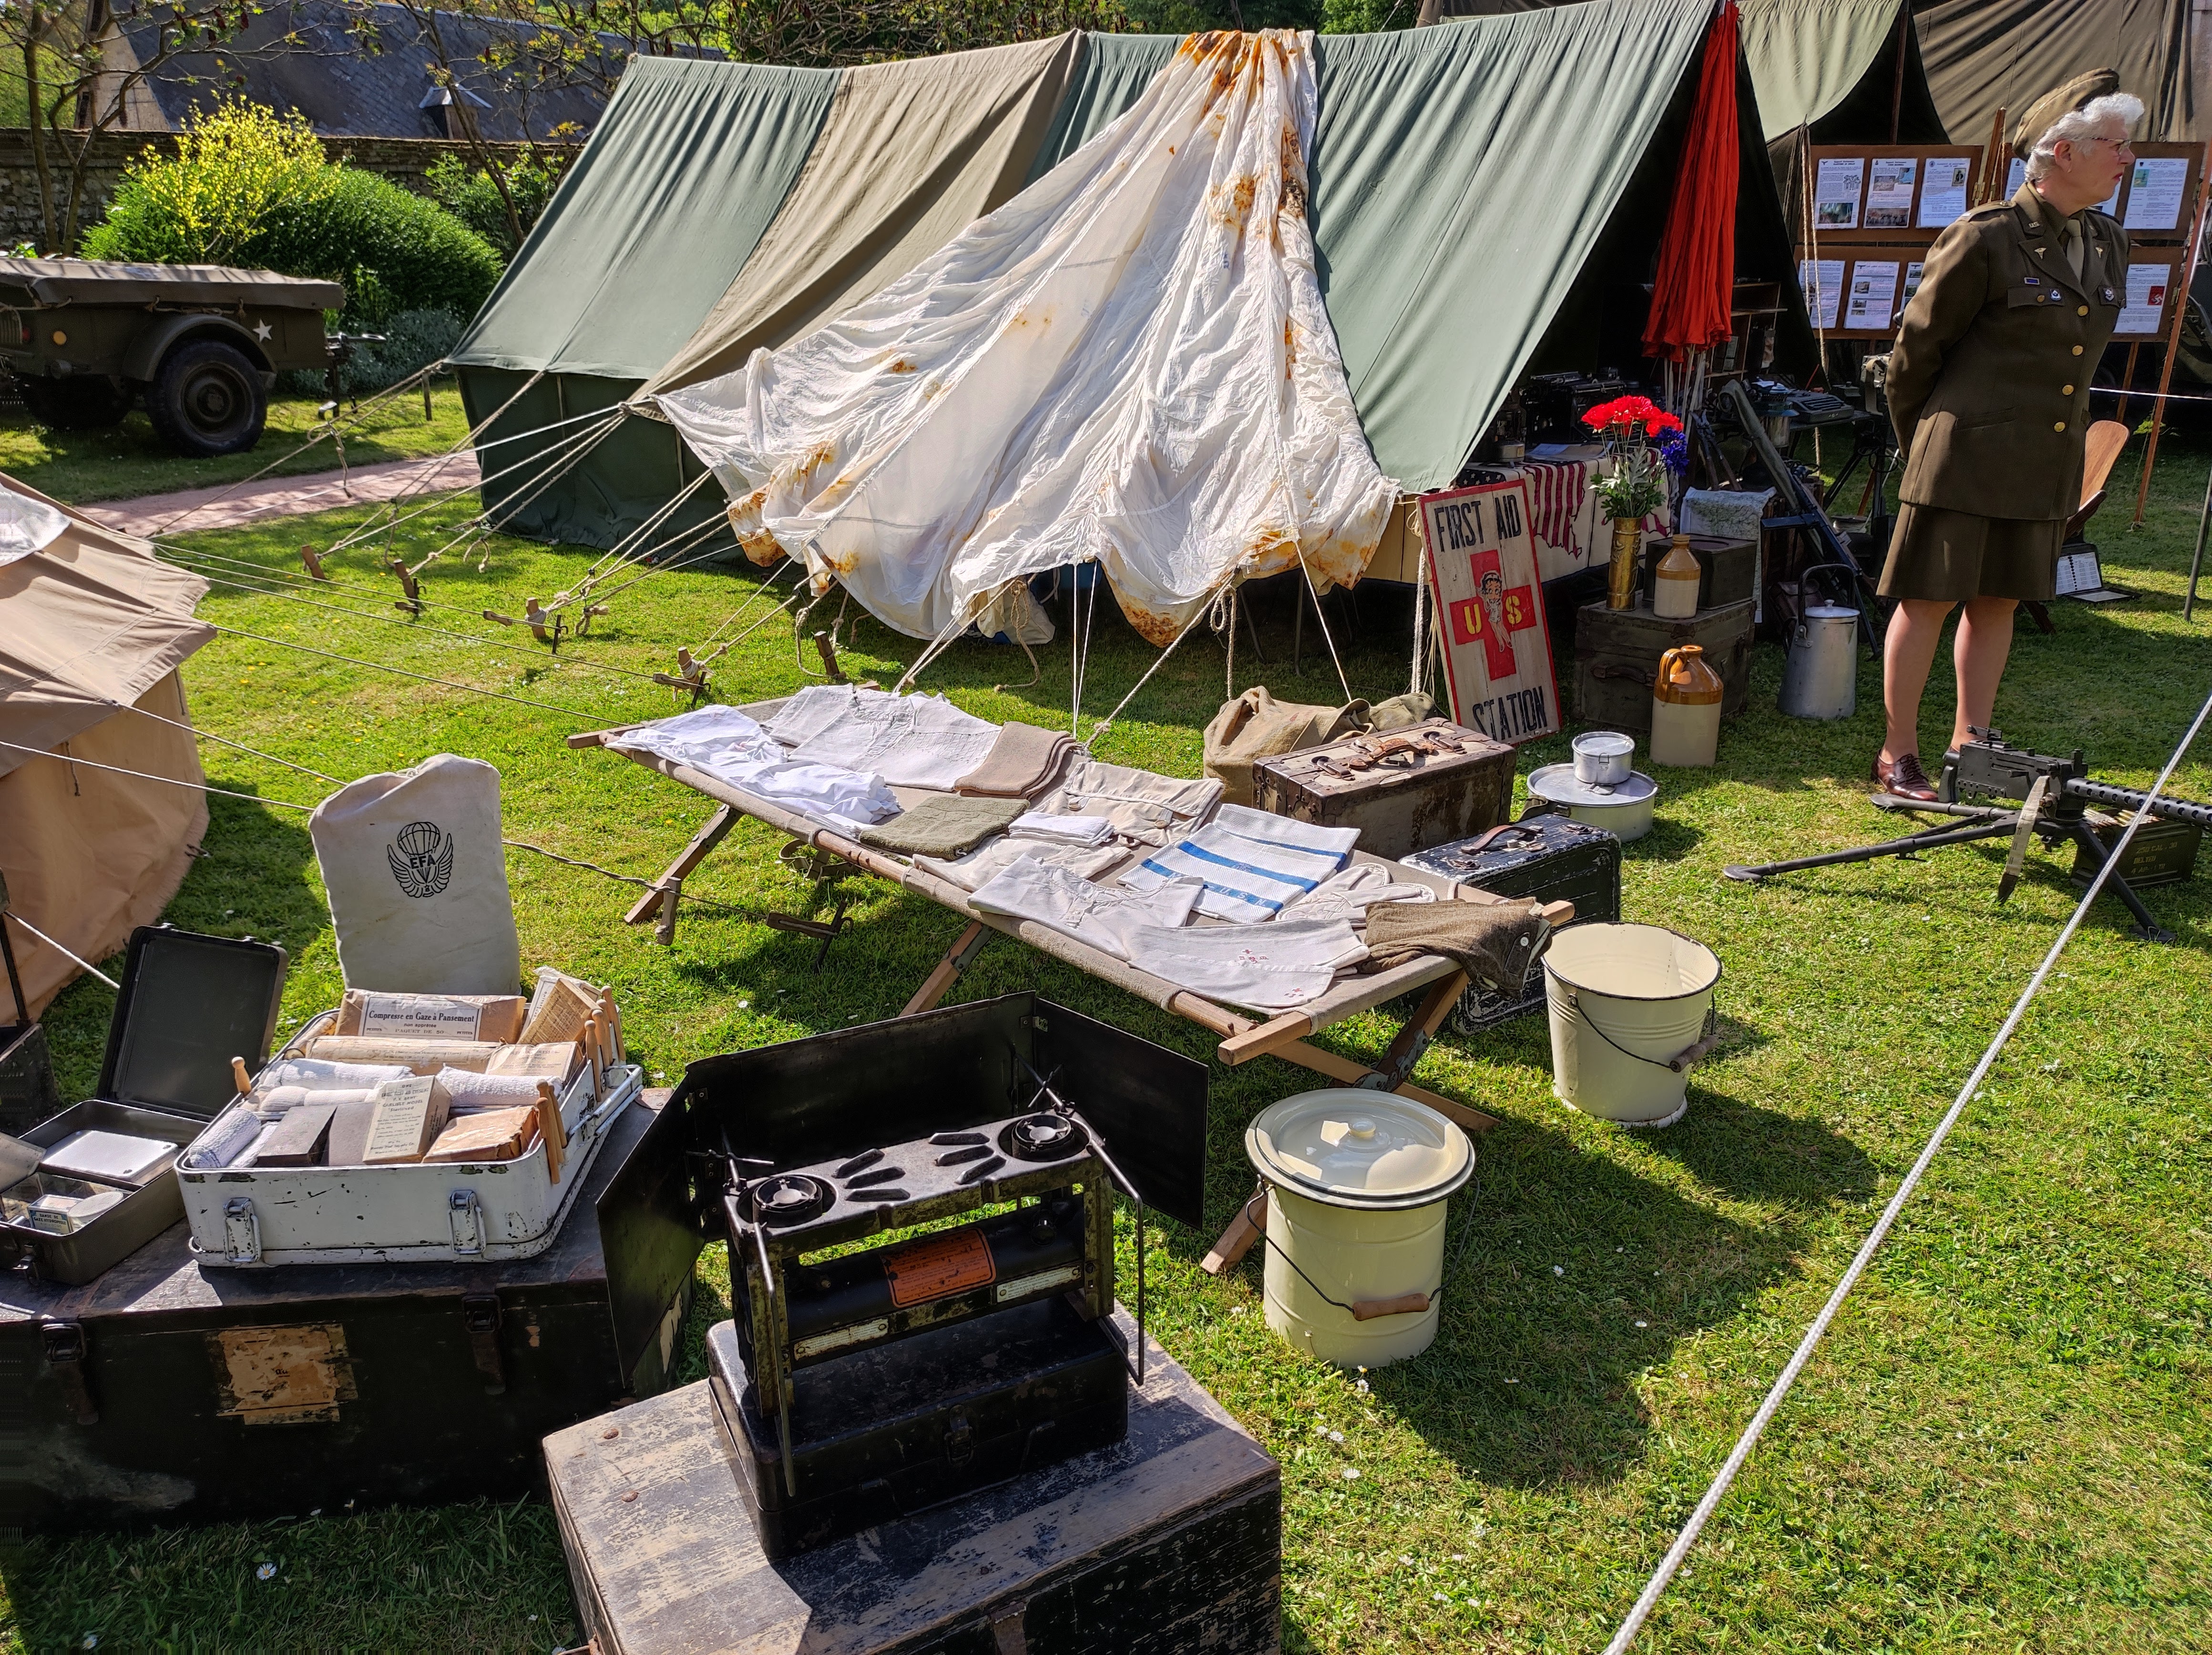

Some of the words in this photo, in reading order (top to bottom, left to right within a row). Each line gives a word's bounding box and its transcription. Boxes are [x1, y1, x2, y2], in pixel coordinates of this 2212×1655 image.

[1434, 501, 1484, 552] FIRST
[1495, 494, 1521, 540] AID
[1464, 603, 1481, 634] U
[1505, 595, 1522, 626] S
[1472, 686, 1548, 742] STATION
[410, 855, 436, 869] EFA
[369, 1011, 404, 1020] Compresse
[416, 1012, 432, 1021] Gaze
[438, 1014, 474, 1022] Pansement
